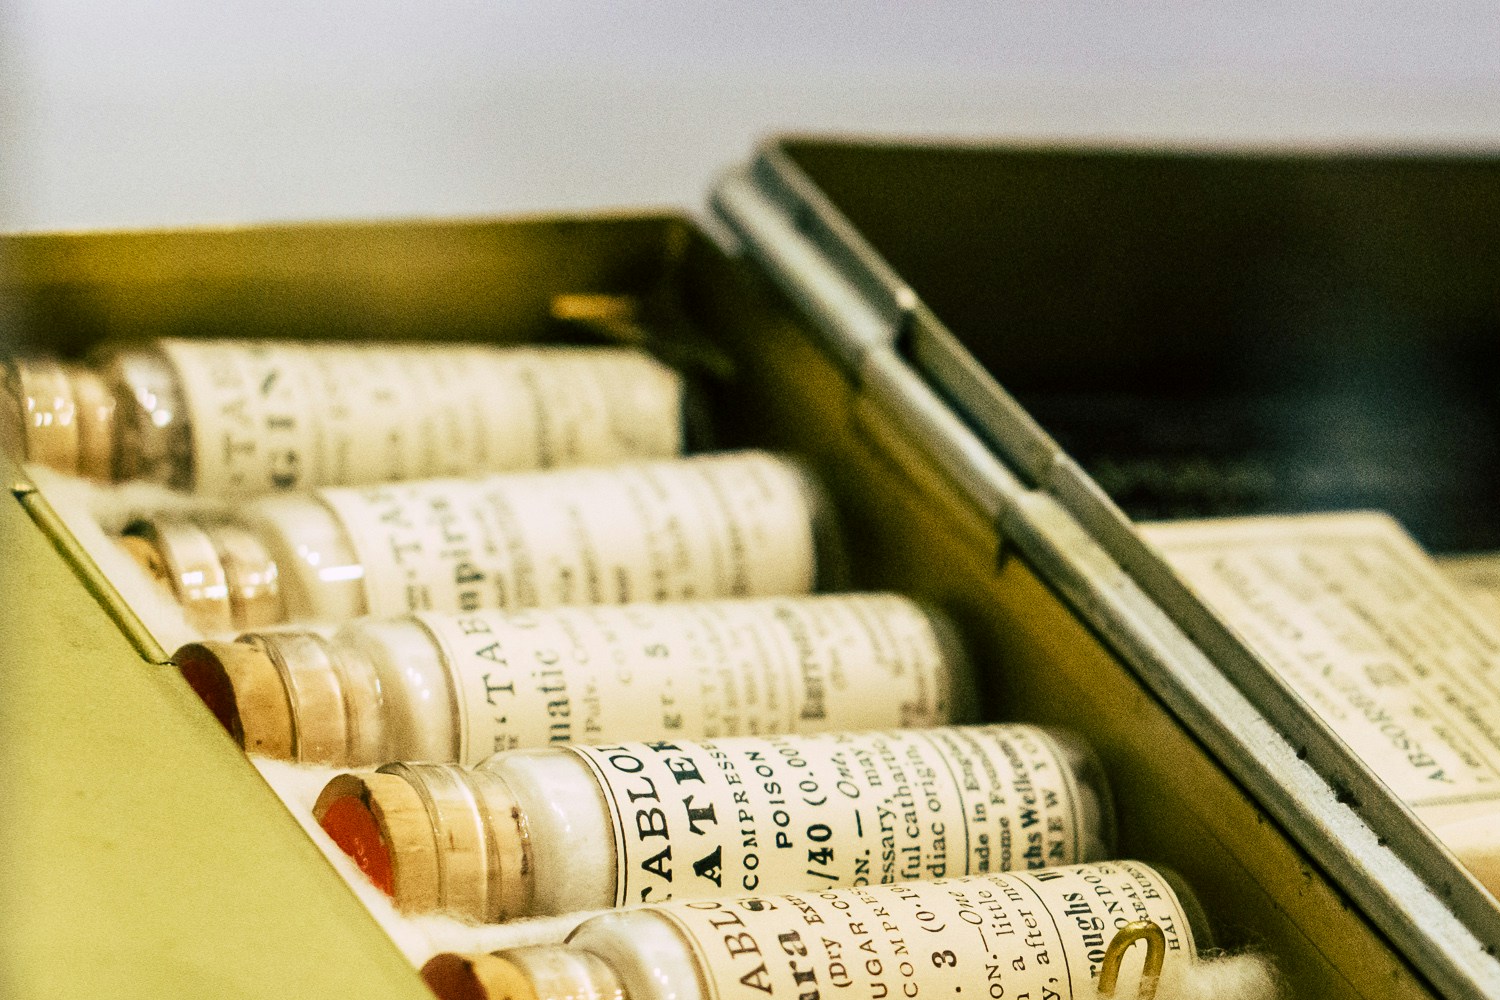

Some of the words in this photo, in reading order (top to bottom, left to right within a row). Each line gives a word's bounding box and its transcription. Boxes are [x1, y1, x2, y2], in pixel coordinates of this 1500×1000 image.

[743, 750, 794, 850] POISON
[806, 822, 841, 891] /40
[977, 889, 1016, 937] little
[1017, 908, 1051, 967] after
[821, 936, 853, 989] (Dry
[931, 948, 958, 970] 3
[1010, 955, 1027, 972] a
